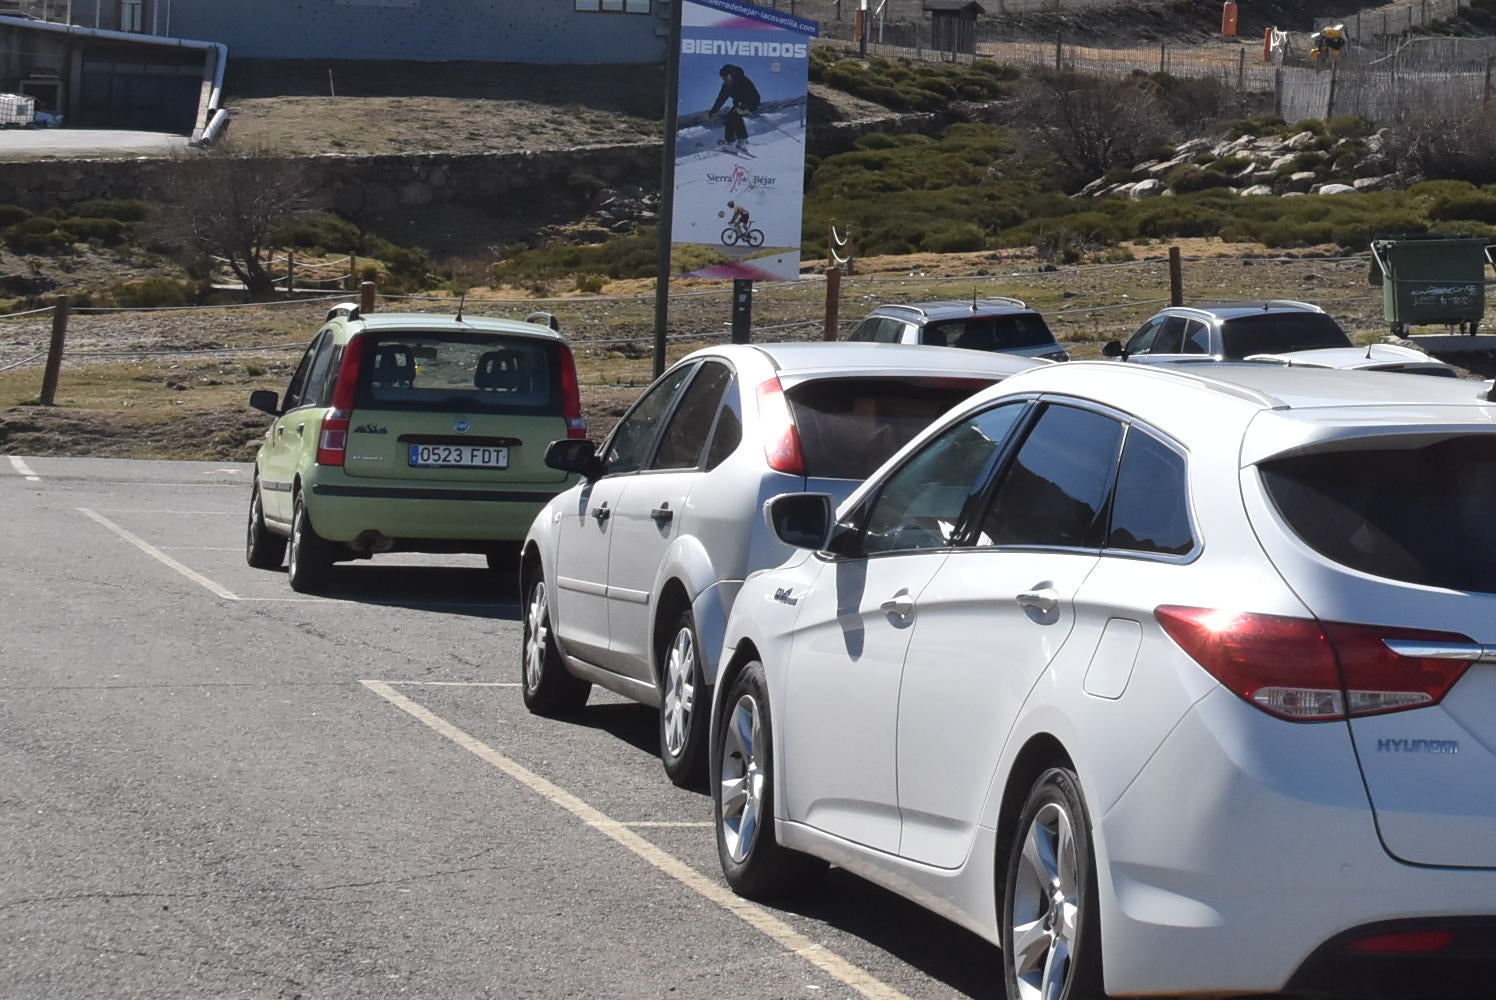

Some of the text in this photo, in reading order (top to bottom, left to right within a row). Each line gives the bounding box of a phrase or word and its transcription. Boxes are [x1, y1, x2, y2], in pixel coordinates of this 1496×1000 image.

[682, 39, 807, 58] BIENVENIDOS
[706, 173, 732, 183] Sierra
[421, 446, 463, 463] 0523
[470, 448, 503, 465] FDT
